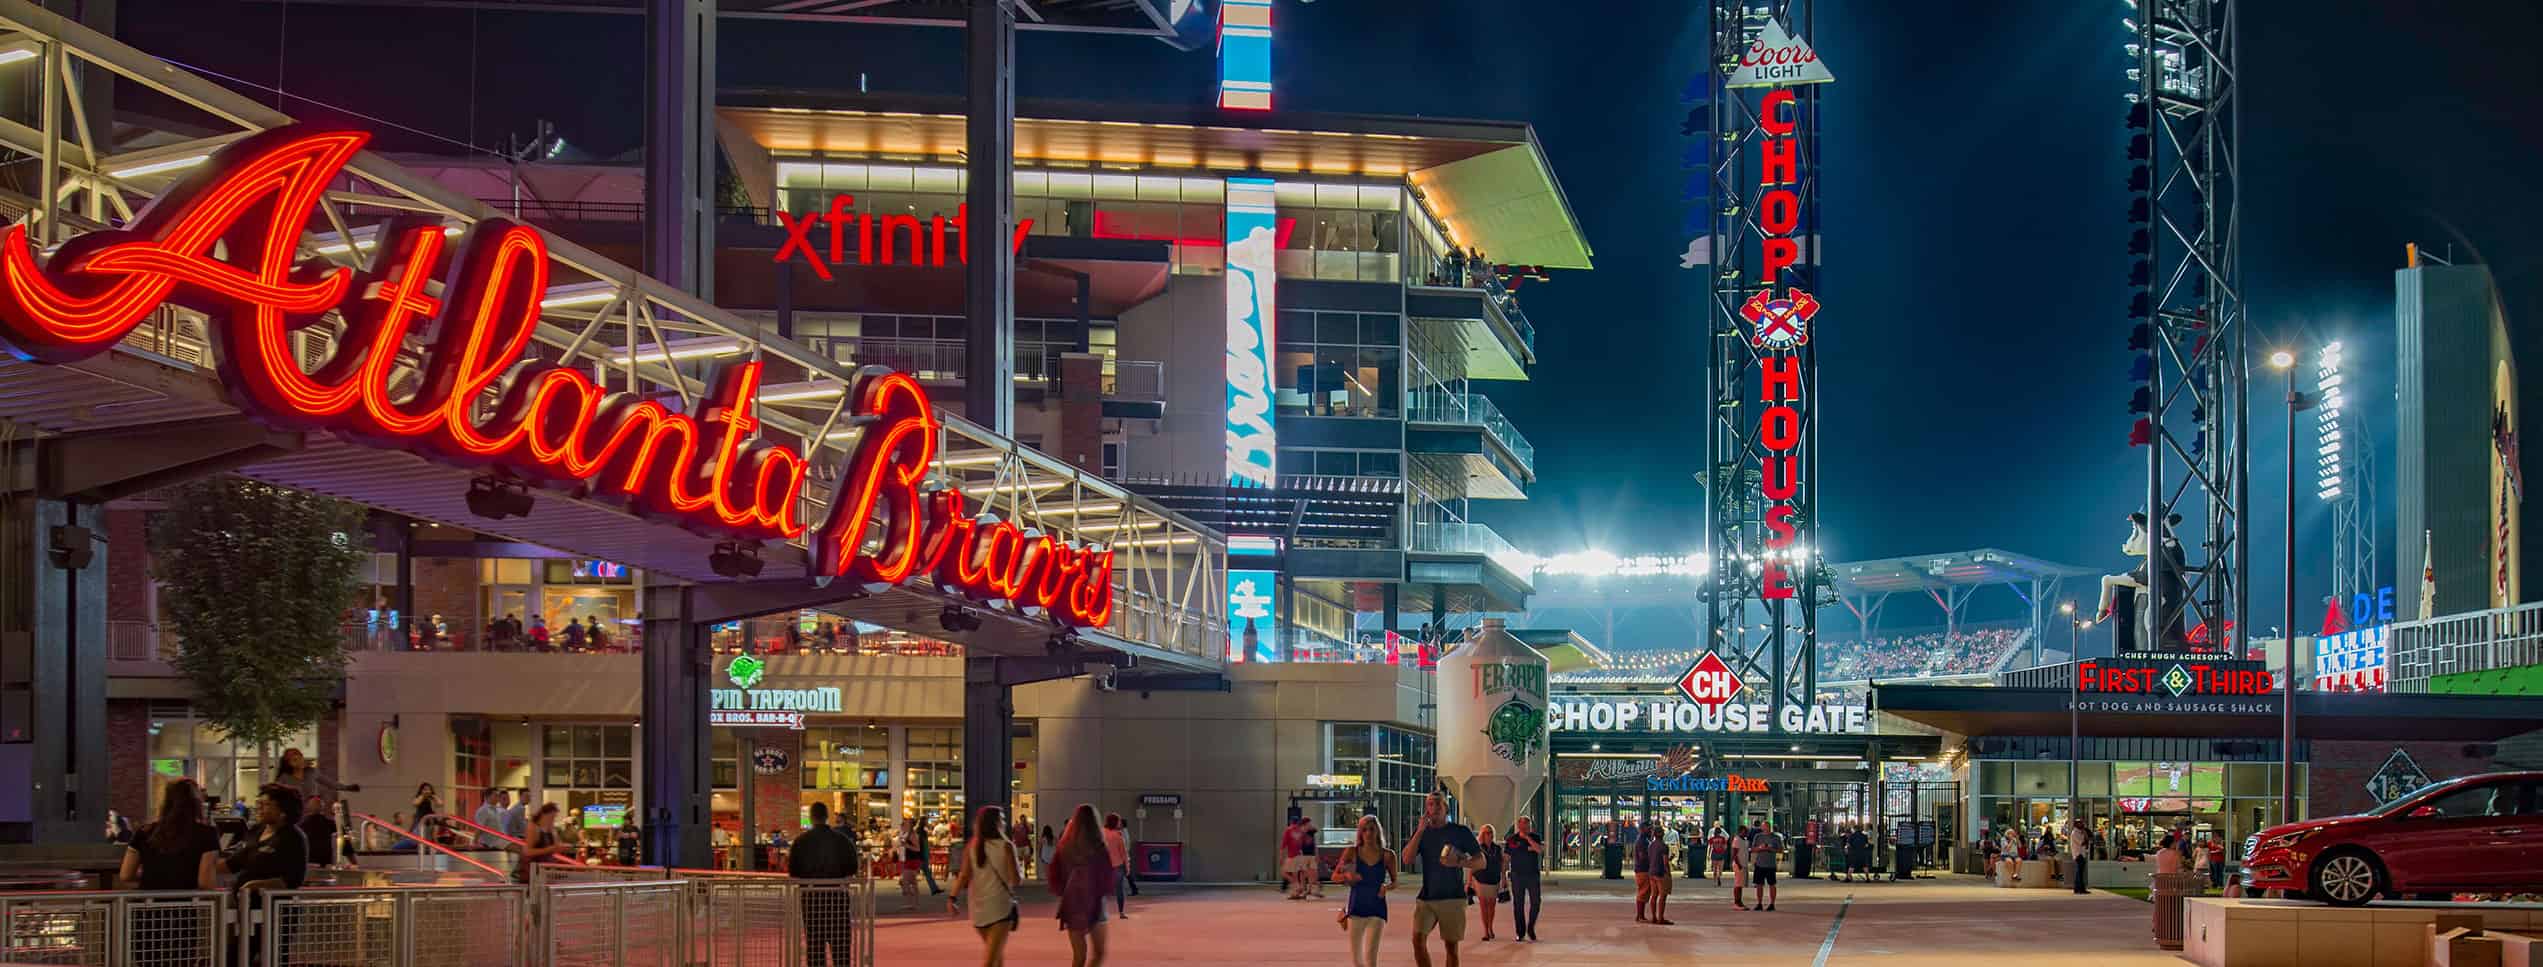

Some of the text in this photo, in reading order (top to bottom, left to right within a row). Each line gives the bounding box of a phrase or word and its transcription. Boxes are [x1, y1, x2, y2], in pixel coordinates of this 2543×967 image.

[1741, 39, 1817, 67] Coors
[1754, 64, 1803, 79] LIGHT
[1761, 89, 1798, 285] CHOP
[773, 194, 1034, 281] xfinit
[3, 130, 1115, 631] Atlanta Braves
[1761, 357, 1799, 600] HOUSE
[2124, 652, 2148, 661] CHEF
[2151, 652, 2176, 661] HUGH
[1692, 670, 1731, 699] CH
[2079, 663, 2274, 695] FIRST & THIRD
[747, 686, 842, 712] TAPROOM
[2101, 702, 2129, 712] DOG
[2135, 703, 2161, 712] AND
[2167, 703, 2225, 713] SAUSAGE
[2230, 704, 2272, 713] SHACK
[1547, 702, 1865, 734] CHOP HOUSE GATE
